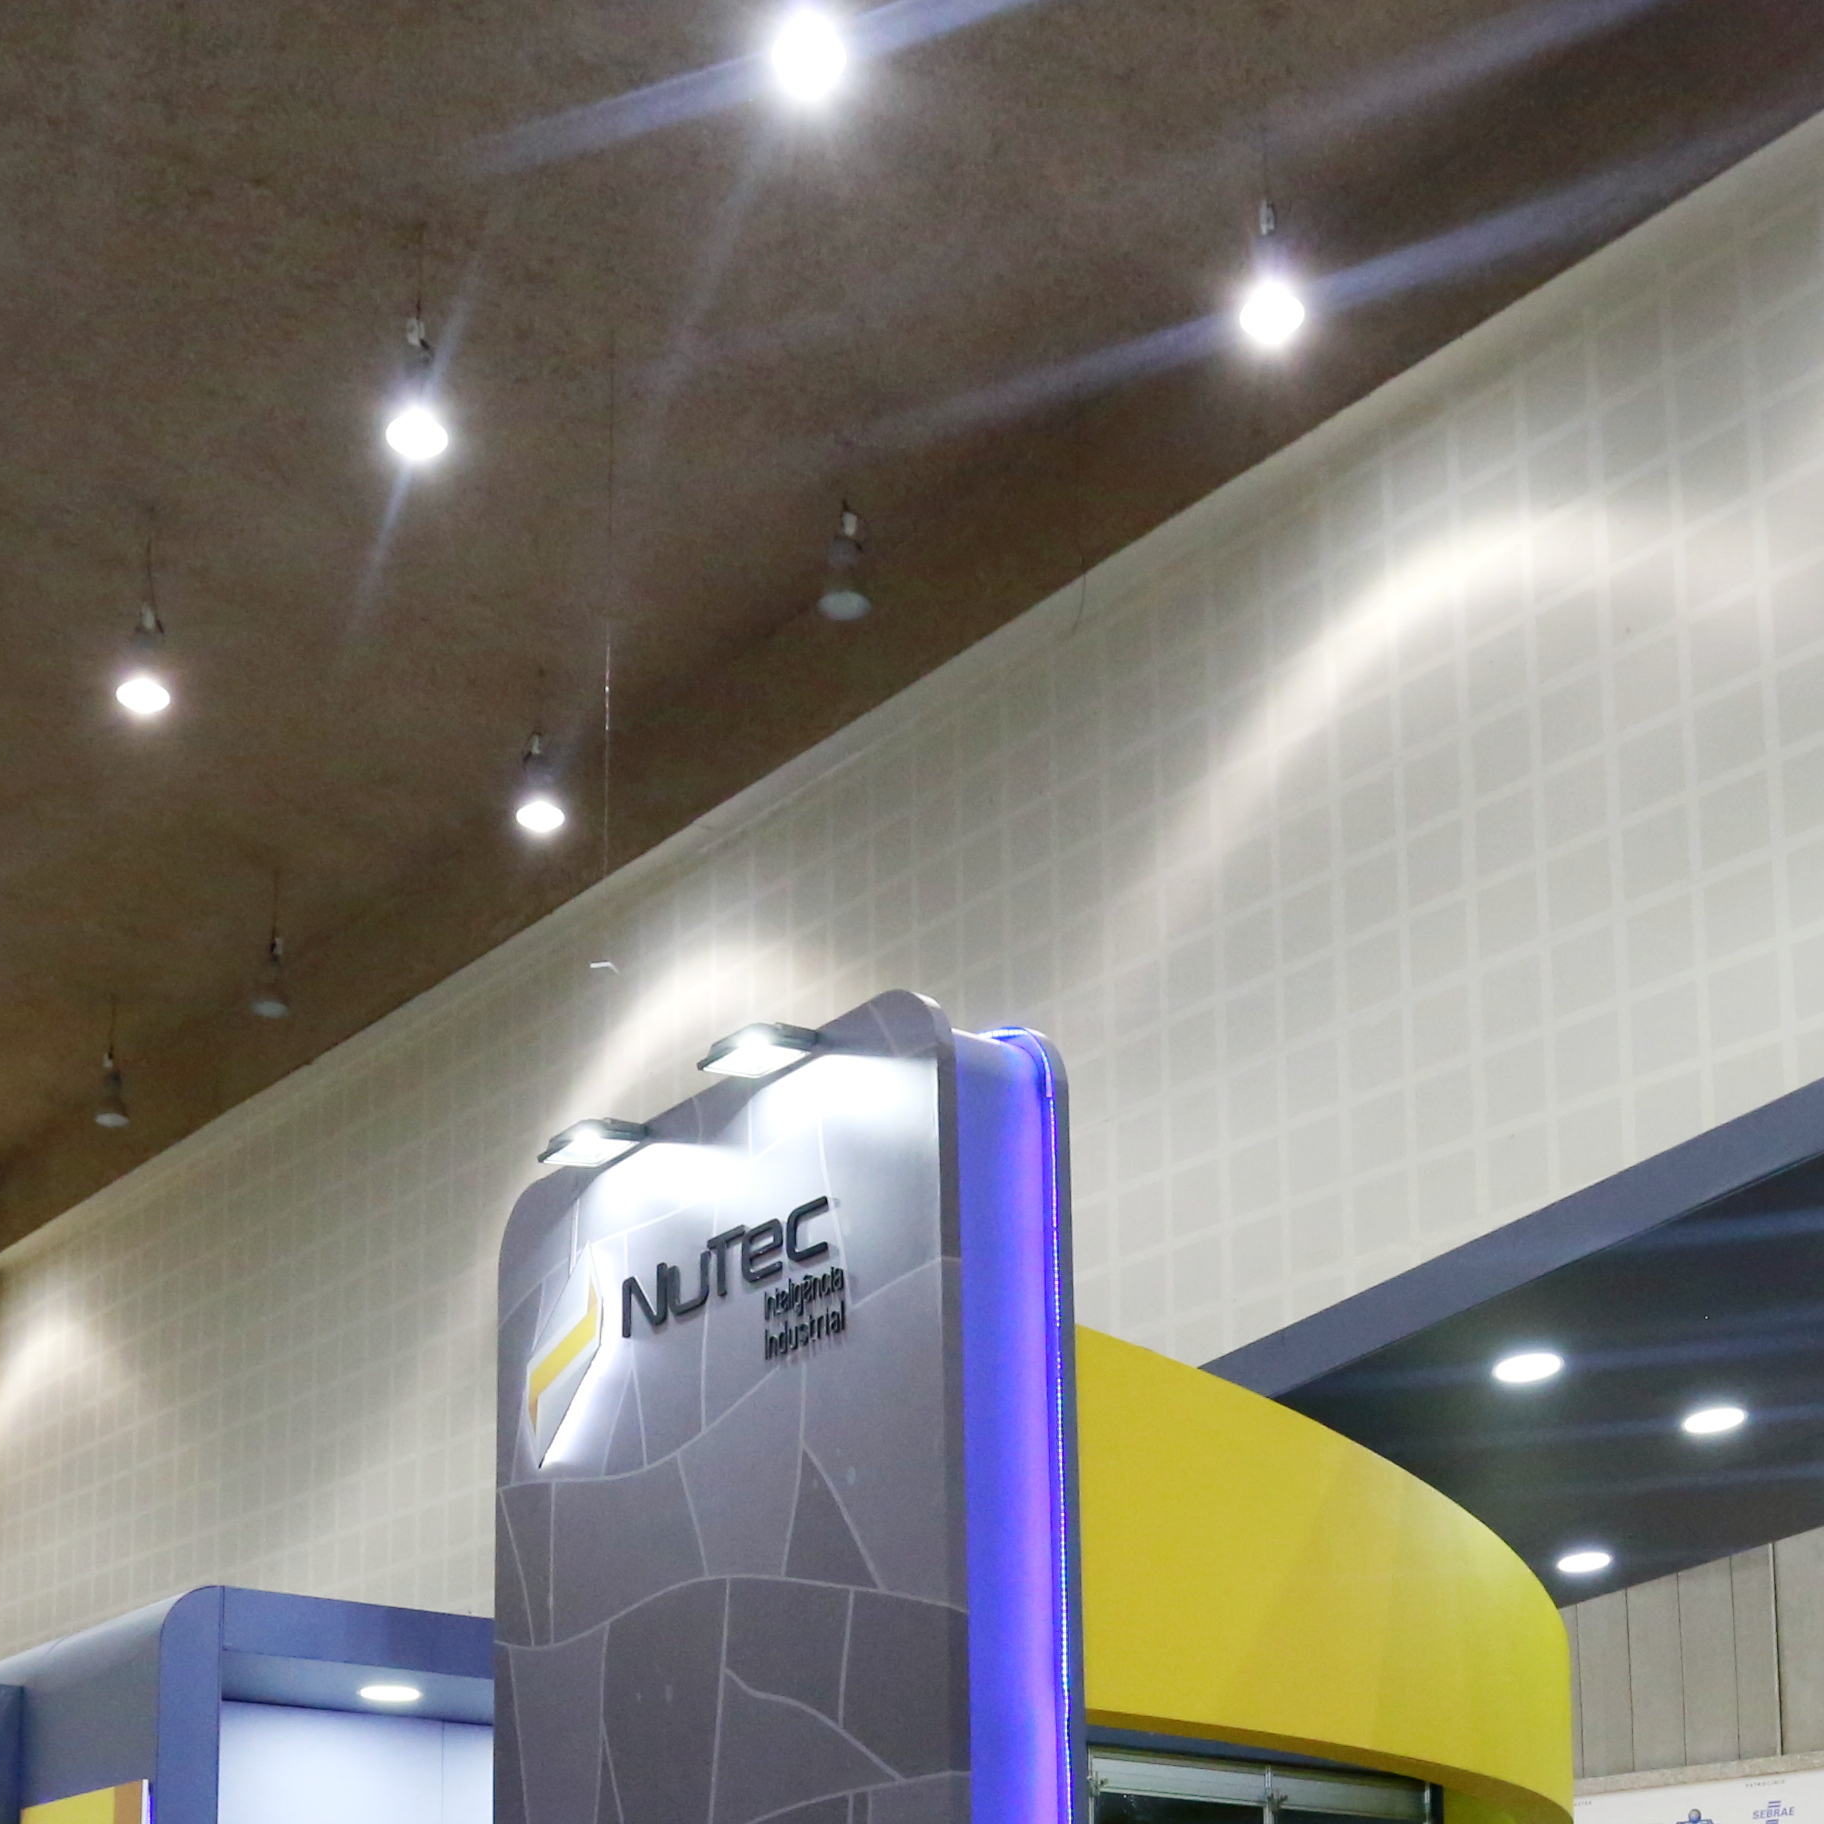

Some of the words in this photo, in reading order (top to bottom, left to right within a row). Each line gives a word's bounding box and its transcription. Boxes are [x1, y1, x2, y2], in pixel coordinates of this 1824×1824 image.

[764, 1266, 844, 1320] Inteligência
[765, 1300, 846, 1360] Industrial
[1752, 1806, 1795, 1820] SEBRAE
